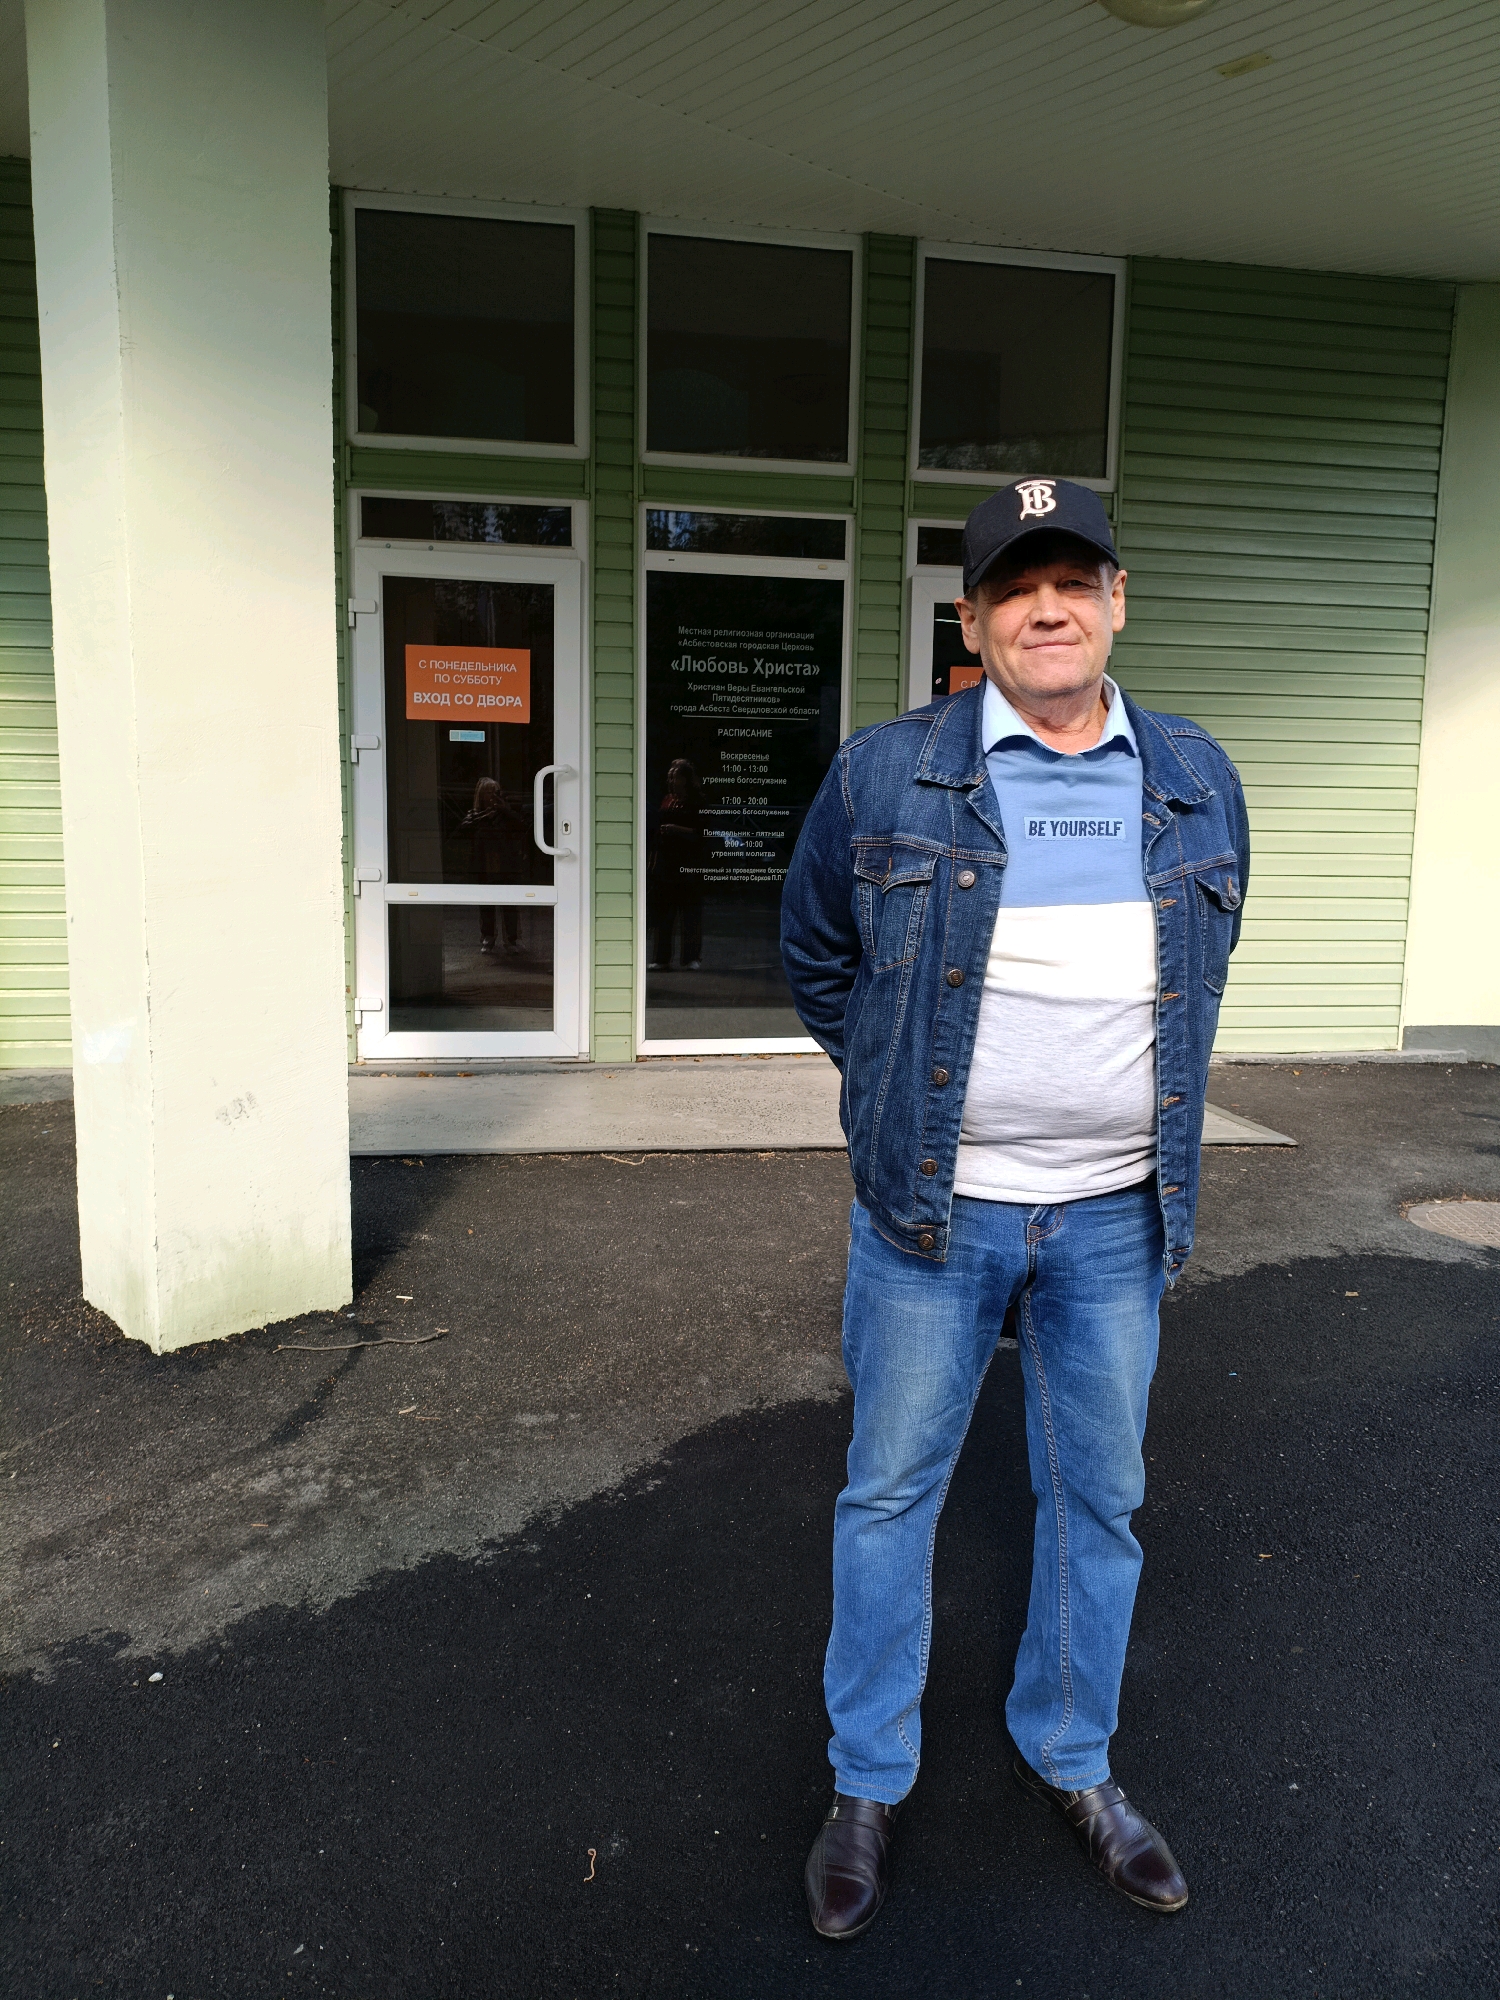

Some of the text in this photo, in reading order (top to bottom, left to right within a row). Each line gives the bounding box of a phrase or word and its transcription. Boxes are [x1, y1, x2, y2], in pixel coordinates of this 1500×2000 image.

[678, 626, 814, 640] Местная религиозная организация
[678, 639, 814, 652] «Асбестовская городская Церковь
[419, 660, 517, 672] С ПОНЕДЕЛЬНИКА
[671, 655, 820, 678] «Любовь Христа»
[434, 674, 502, 685] ПО СУББОТУ
[688, 682, 805, 694] Христиан Веры Евангельской
[414, 692, 522, 708] ВХОД СО ДВОРА
[670, 704, 820, 715] города Асбеста Свердловской области
[718, 729, 773, 738] РАСПИСАНИЕ
[721, 751, 770, 761] Воскресенье
[722, 765, 741, 773] 11:00
[749, 765, 768, 773] 13:00
[702, 776, 735, 784] утреннее
[721, 797, 741, 805] 17:00
[748, 797, 768, 805] 20:00
[1029, 820, 1122, 836] BE YOURSELF
